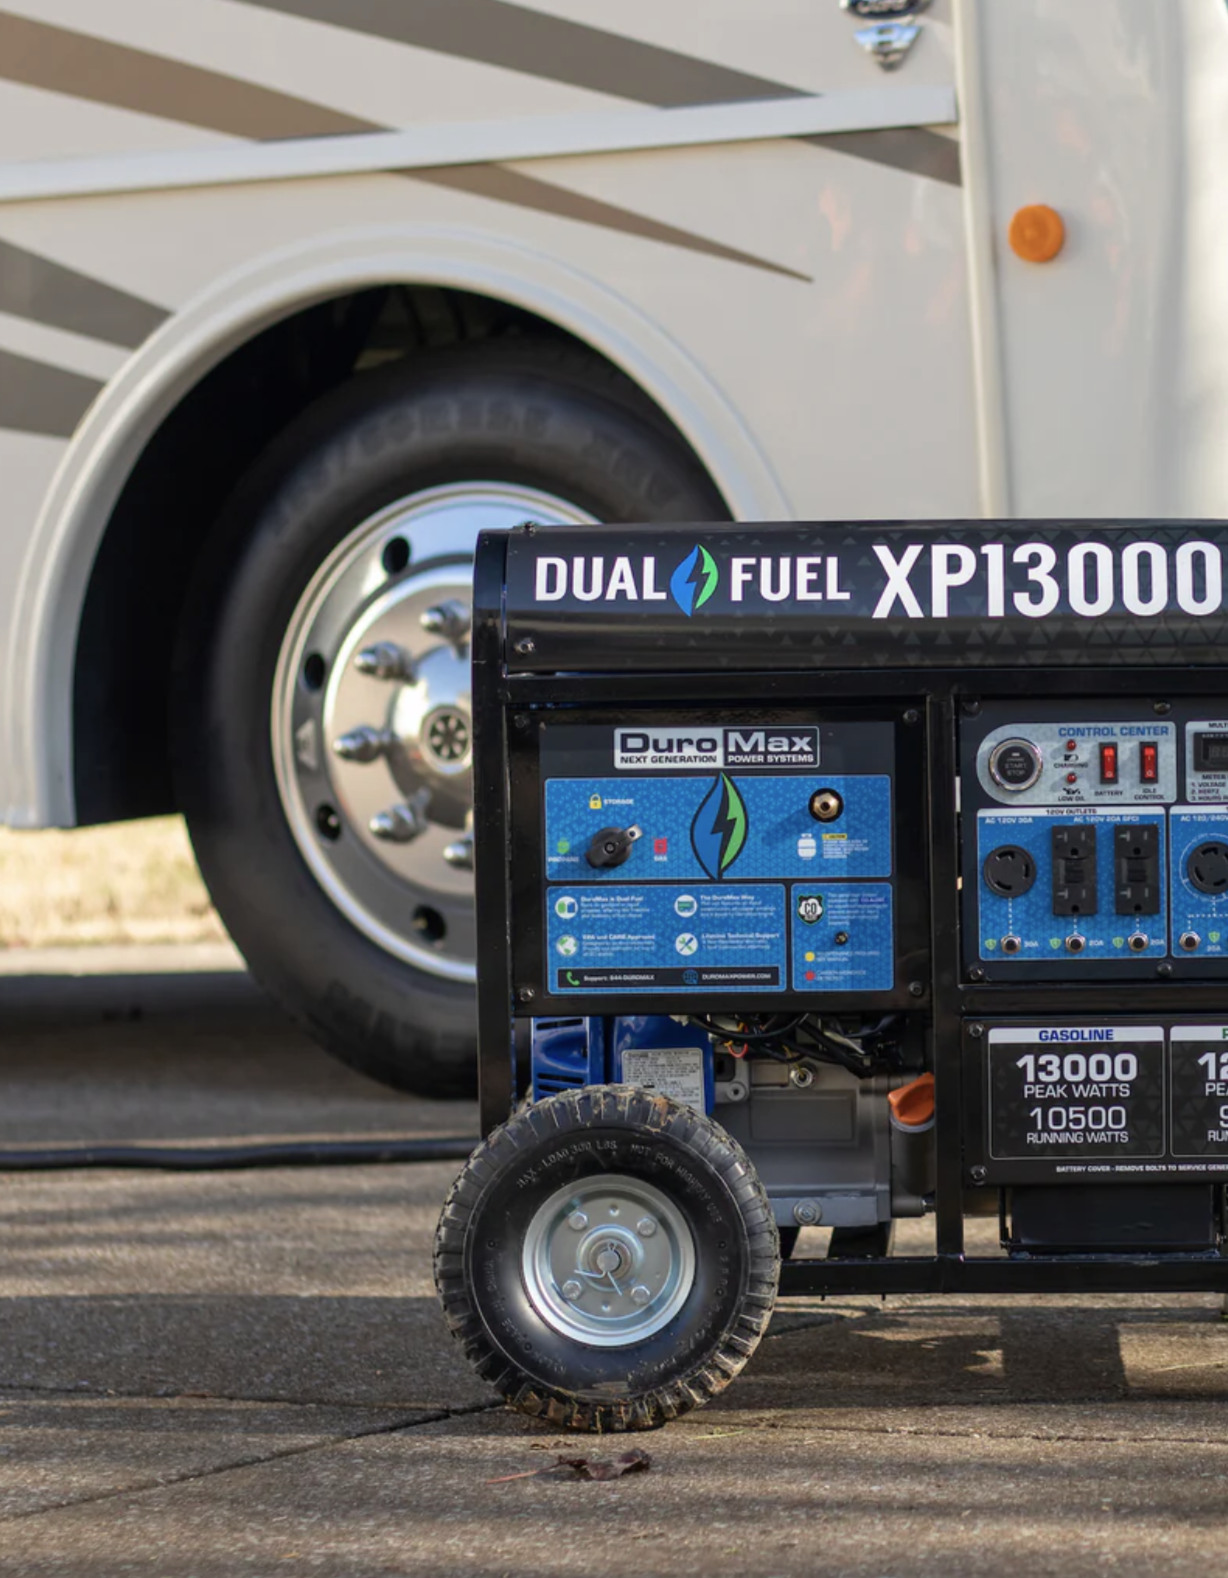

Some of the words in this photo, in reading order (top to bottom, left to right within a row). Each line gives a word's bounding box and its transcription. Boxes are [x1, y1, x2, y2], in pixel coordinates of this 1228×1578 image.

[535, 556, 667, 601] DUAL
[730, 556, 850, 601] FUEL
[1058, 726, 1117, 737] CONTROL
[1120, 726, 1169, 736] CENTER
[620, 755, 648, 765] NEXT
[650, 755, 717, 764] GENERATION
[728, 754, 764, 763] POWER
[767, 754, 814, 763] SYSTEMS
[804, 902, 817, 914] CO
[1038, 1029, 1114, 1041] GASOLINE
[1015, 1053, 1138, 1083] 13000
[1024, 1084, 1067, 1098] PEAK
[1072, 1083, 1130, 1097] WATTS
[1029, 1106, 1126, 1130] 10500
[1026, 1131, 1084, 1144] RUNNING
[1085, 1130, 1129, 1143] WATTS
[655, 1152, 675, 1169] FOR
